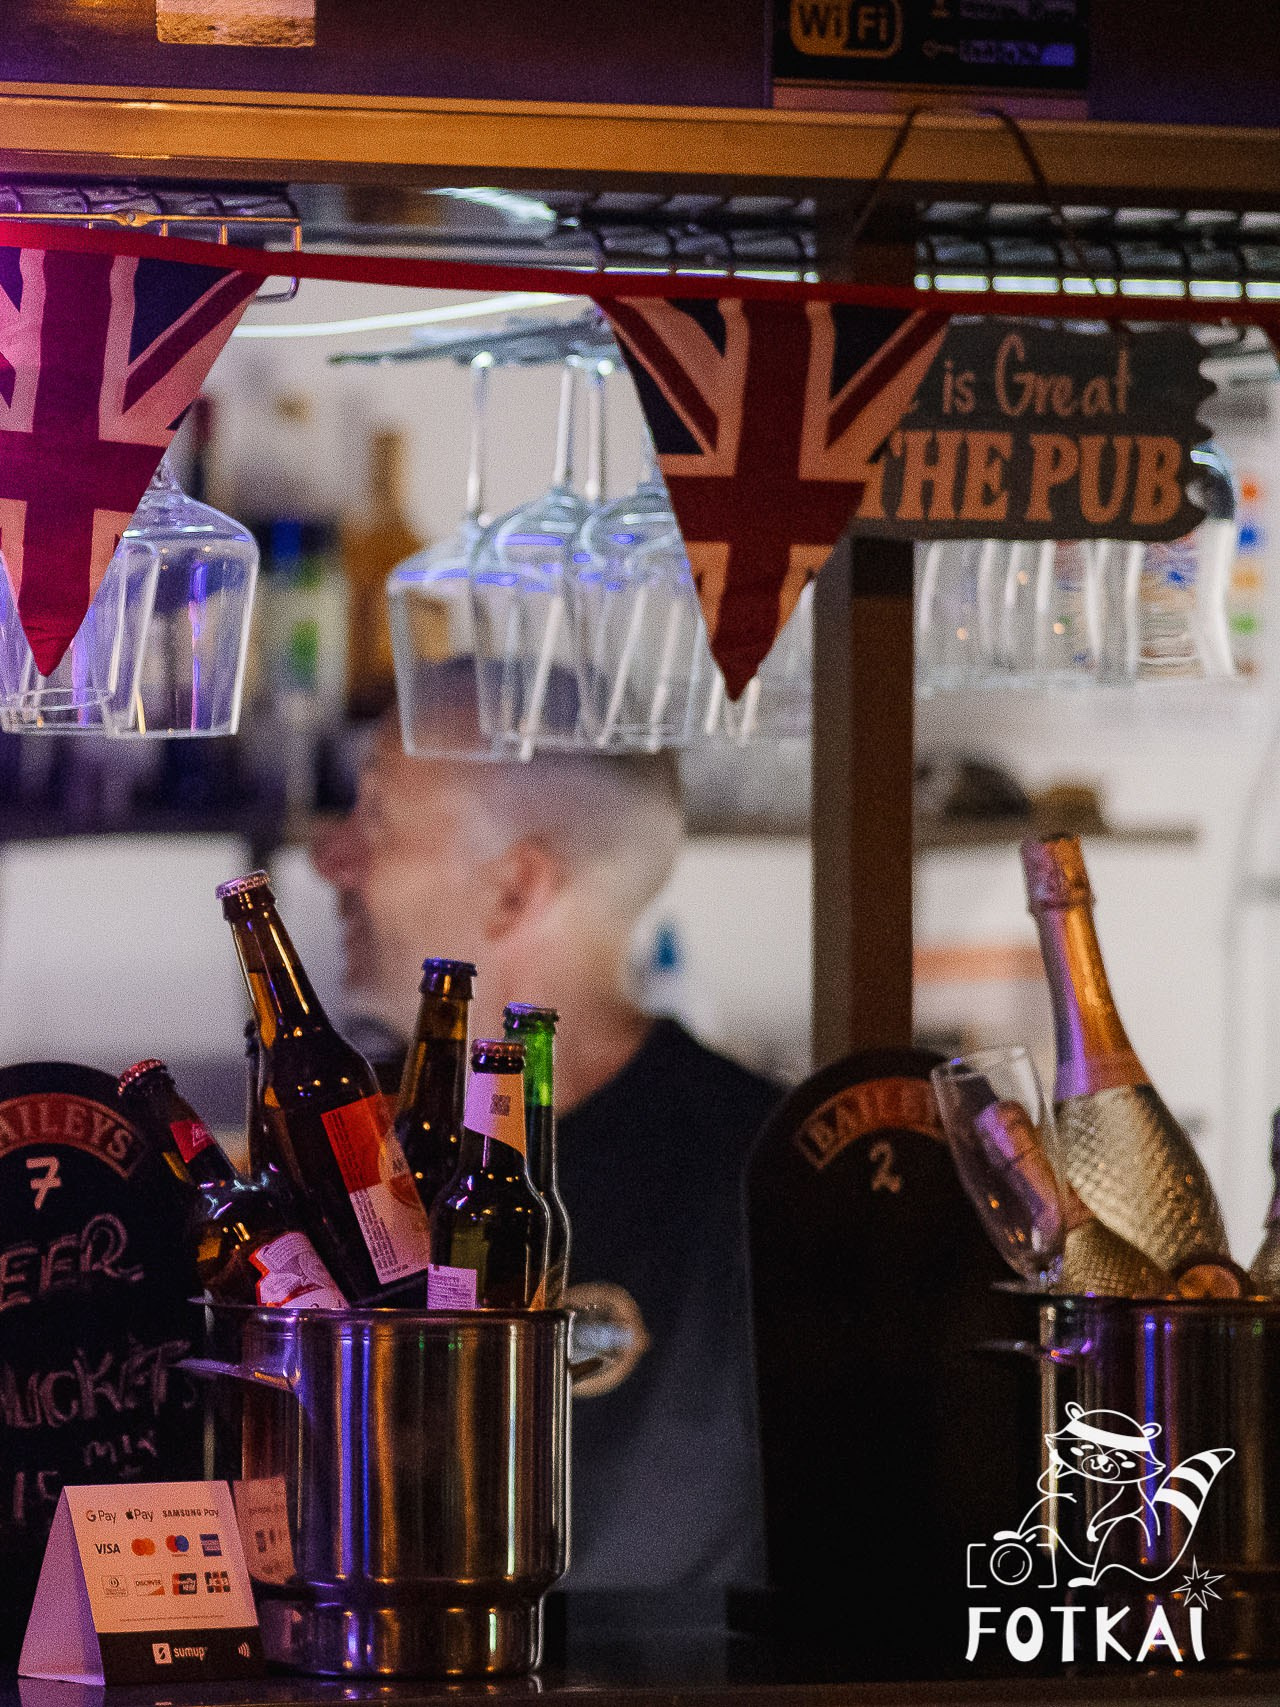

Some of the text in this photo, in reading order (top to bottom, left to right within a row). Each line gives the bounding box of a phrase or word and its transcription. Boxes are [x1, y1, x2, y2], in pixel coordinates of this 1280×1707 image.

[942, 332, 1133, 418] is Great
[1025, 433, 1183, 526] PUB
[25, 1155, 62, 1210] 7
[94, 1543, 120, 1555] VISA
